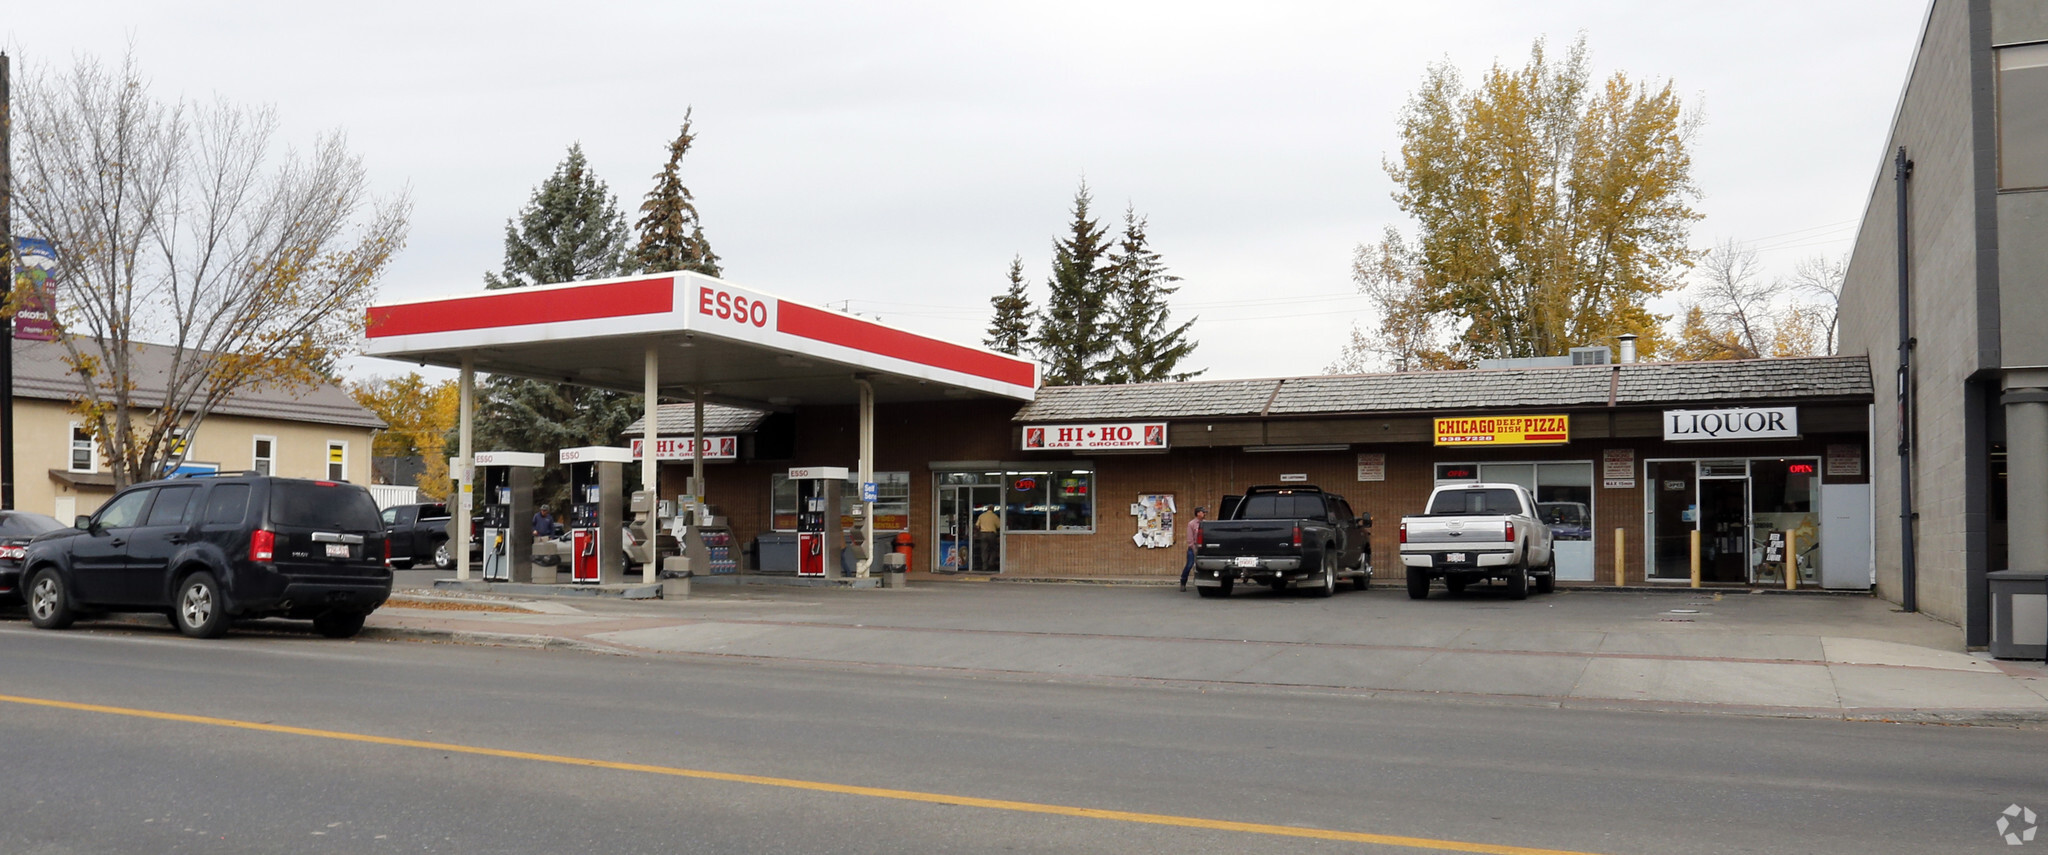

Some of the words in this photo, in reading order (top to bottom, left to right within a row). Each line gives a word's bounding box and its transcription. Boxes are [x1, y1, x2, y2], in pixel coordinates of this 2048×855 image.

[699, 286, 768, 328] ESSO
[1438, 420, 1495, 434] CHICAGO
[1524, 418, 1566, 432] PIZZA
[1672, 411, 1788, 437] LIQUOR
[1058, 427, 1084, 442] HI
[1100, 426, 1133, 441] HO
[476, 455, 493, 463] ESSO
[561, 451, 580, 460] ESSO
[1789, 464, 1813, 473] OPEN
[864, 484, 875, 492] Self
[1015, 480, 1036, 489] OPEN
